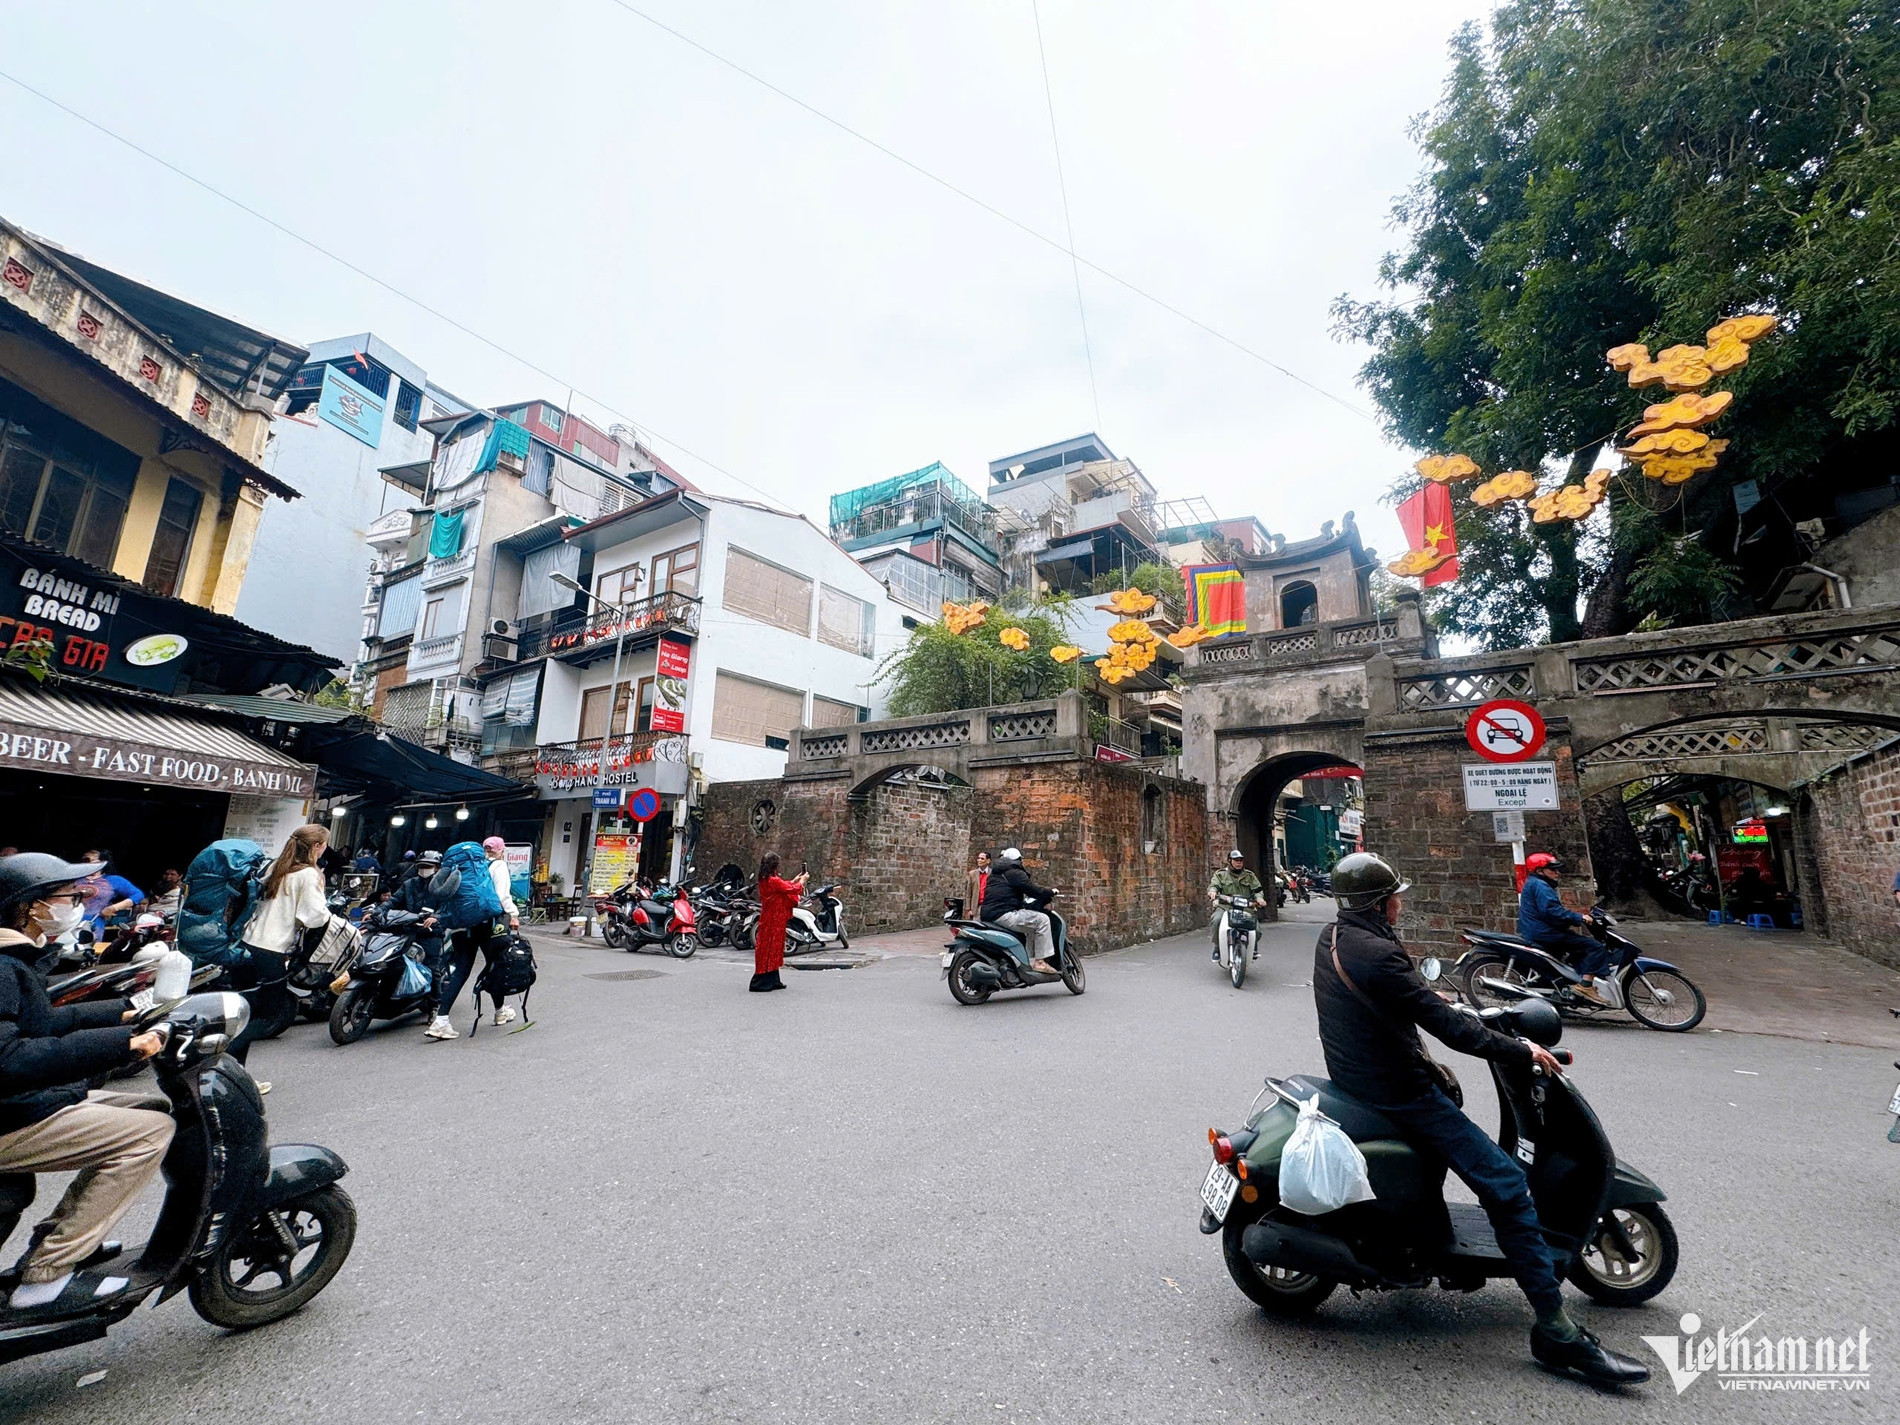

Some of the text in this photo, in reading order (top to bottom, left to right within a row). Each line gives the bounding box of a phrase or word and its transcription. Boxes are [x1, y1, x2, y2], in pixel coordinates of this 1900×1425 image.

[20, 568, 120, 615] BÁNH MÌ
[24, 594, 100, 631] BREAD
[64, 635, 110, 671] GIA
[671, 664, 686, 674] Loop
[91, 746, 156, 775] FAST
[159, 757, 220, 783] FOOD
[233, 767, 281, 790] BANH
[603, 771, 638, 785] HOSTEL
[1498, 798, 1527, 807] Except
[507, 853, 528, 862] Giang
